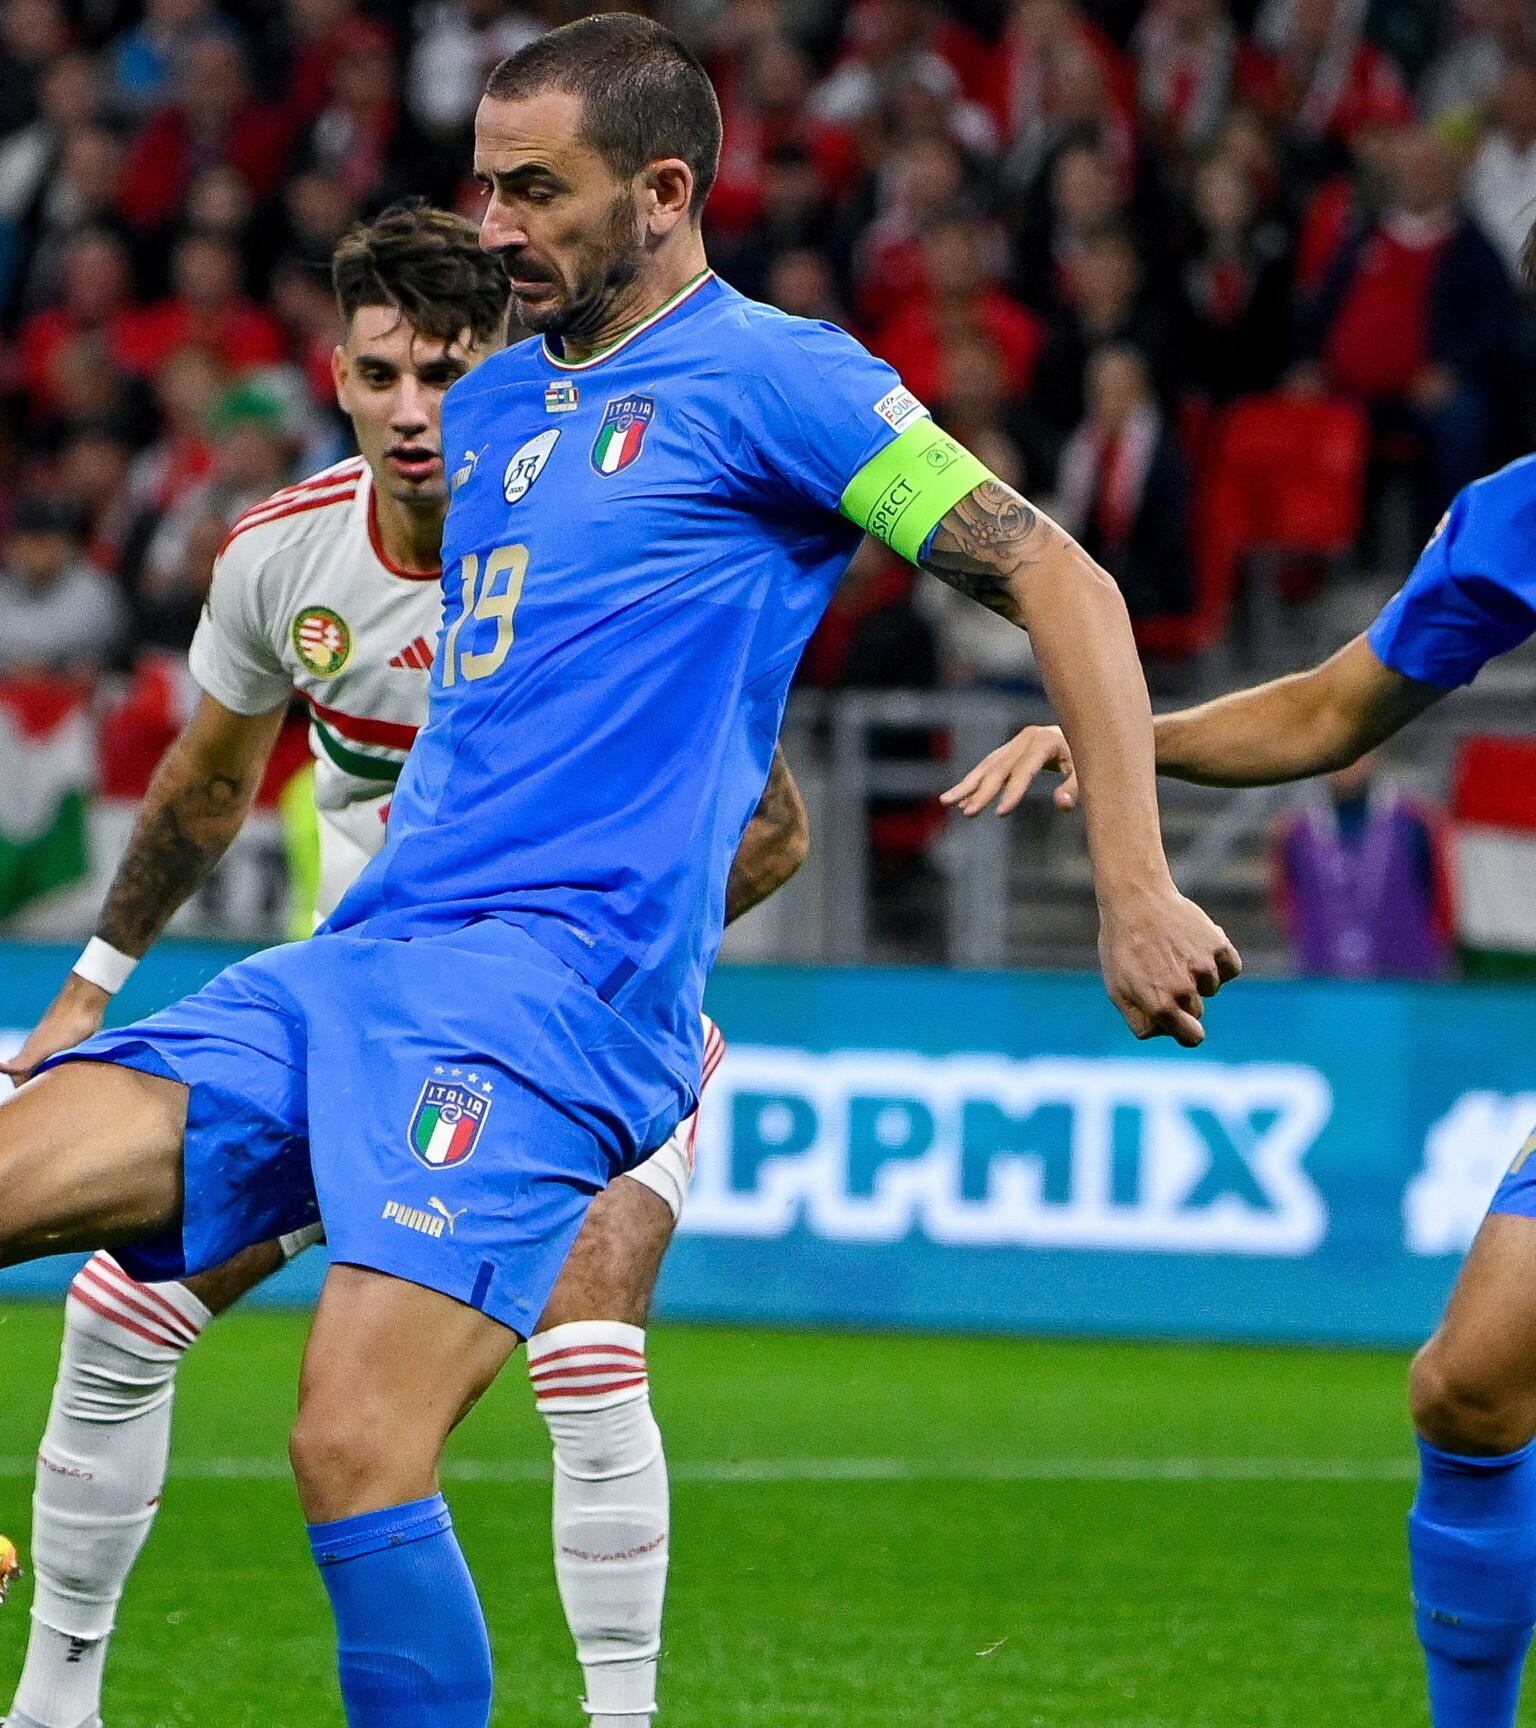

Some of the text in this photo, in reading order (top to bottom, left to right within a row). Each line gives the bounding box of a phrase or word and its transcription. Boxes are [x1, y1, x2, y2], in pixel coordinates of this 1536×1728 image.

[608, 401, 652, 417] ITALIA
[441, 543, 530, 688] 19
[425, 1086, 483, 1115] ITALIA
[382, 1200, 445, 1238] PUMA
